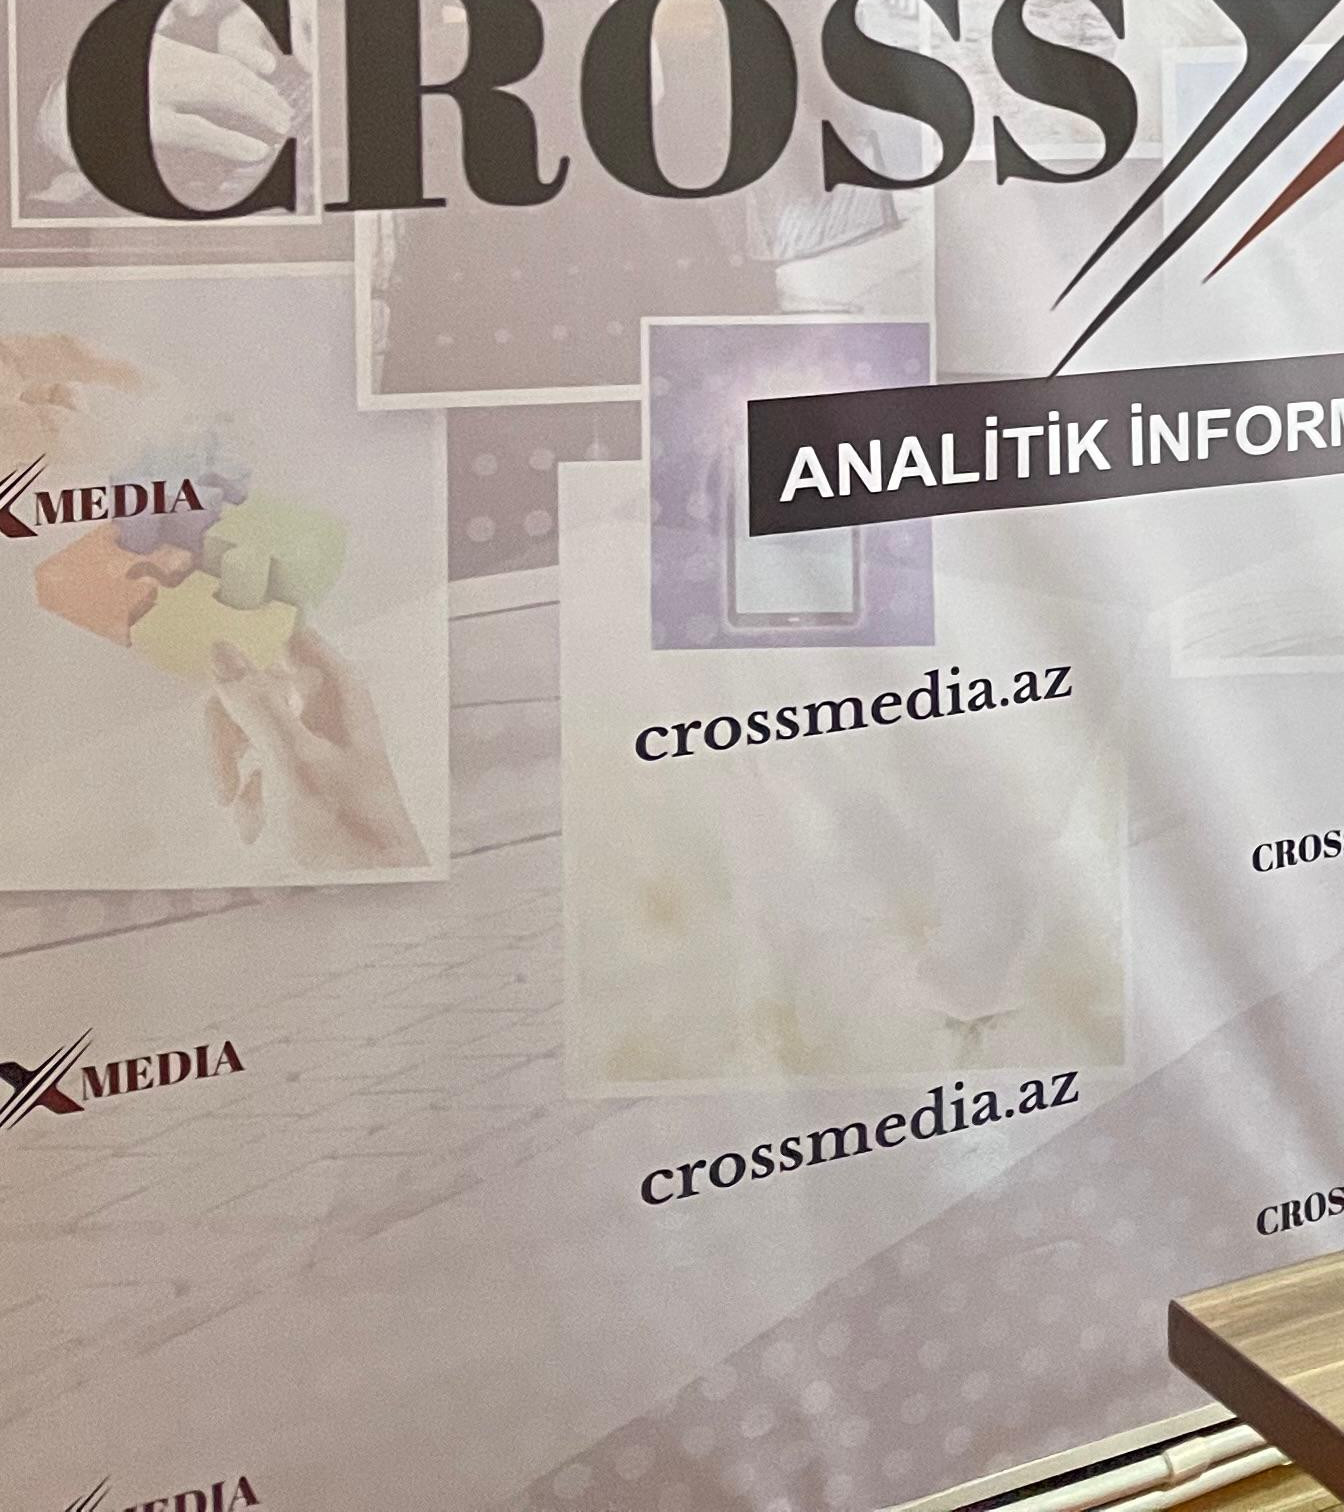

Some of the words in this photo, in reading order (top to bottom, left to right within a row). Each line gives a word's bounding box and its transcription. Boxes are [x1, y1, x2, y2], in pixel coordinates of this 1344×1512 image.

[33, 478, 204, 526] MEDIA
[779, 410, 1111, 502] ANALİTİK
[635, 661, 1073, 762] crossmedia.az
[640, 1069, 1080, 1205] crossmedia.az
